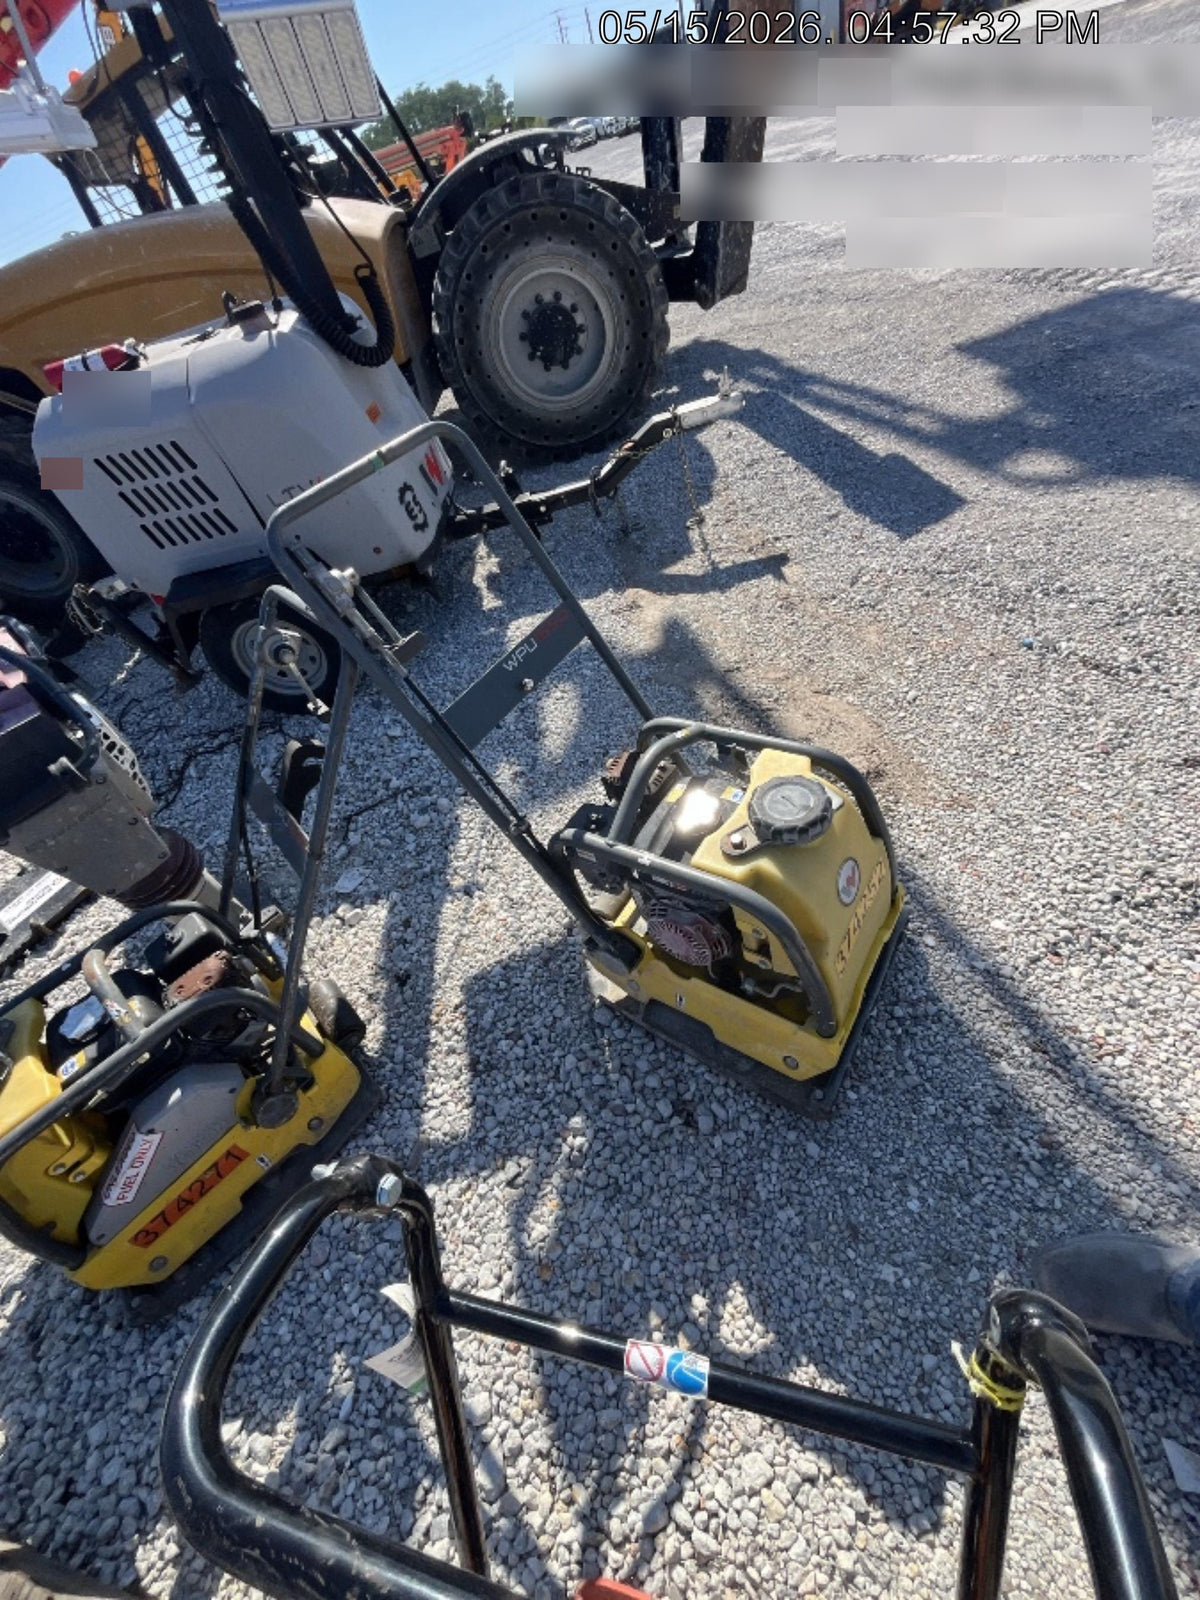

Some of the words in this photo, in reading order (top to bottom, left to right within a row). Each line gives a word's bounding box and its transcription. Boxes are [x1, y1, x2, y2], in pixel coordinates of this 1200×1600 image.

[117, 1170, 141, 1201] FUEL
[131, 1138, 153, 1169] ONLY
[133, 1149, 244, 1246] 374271
